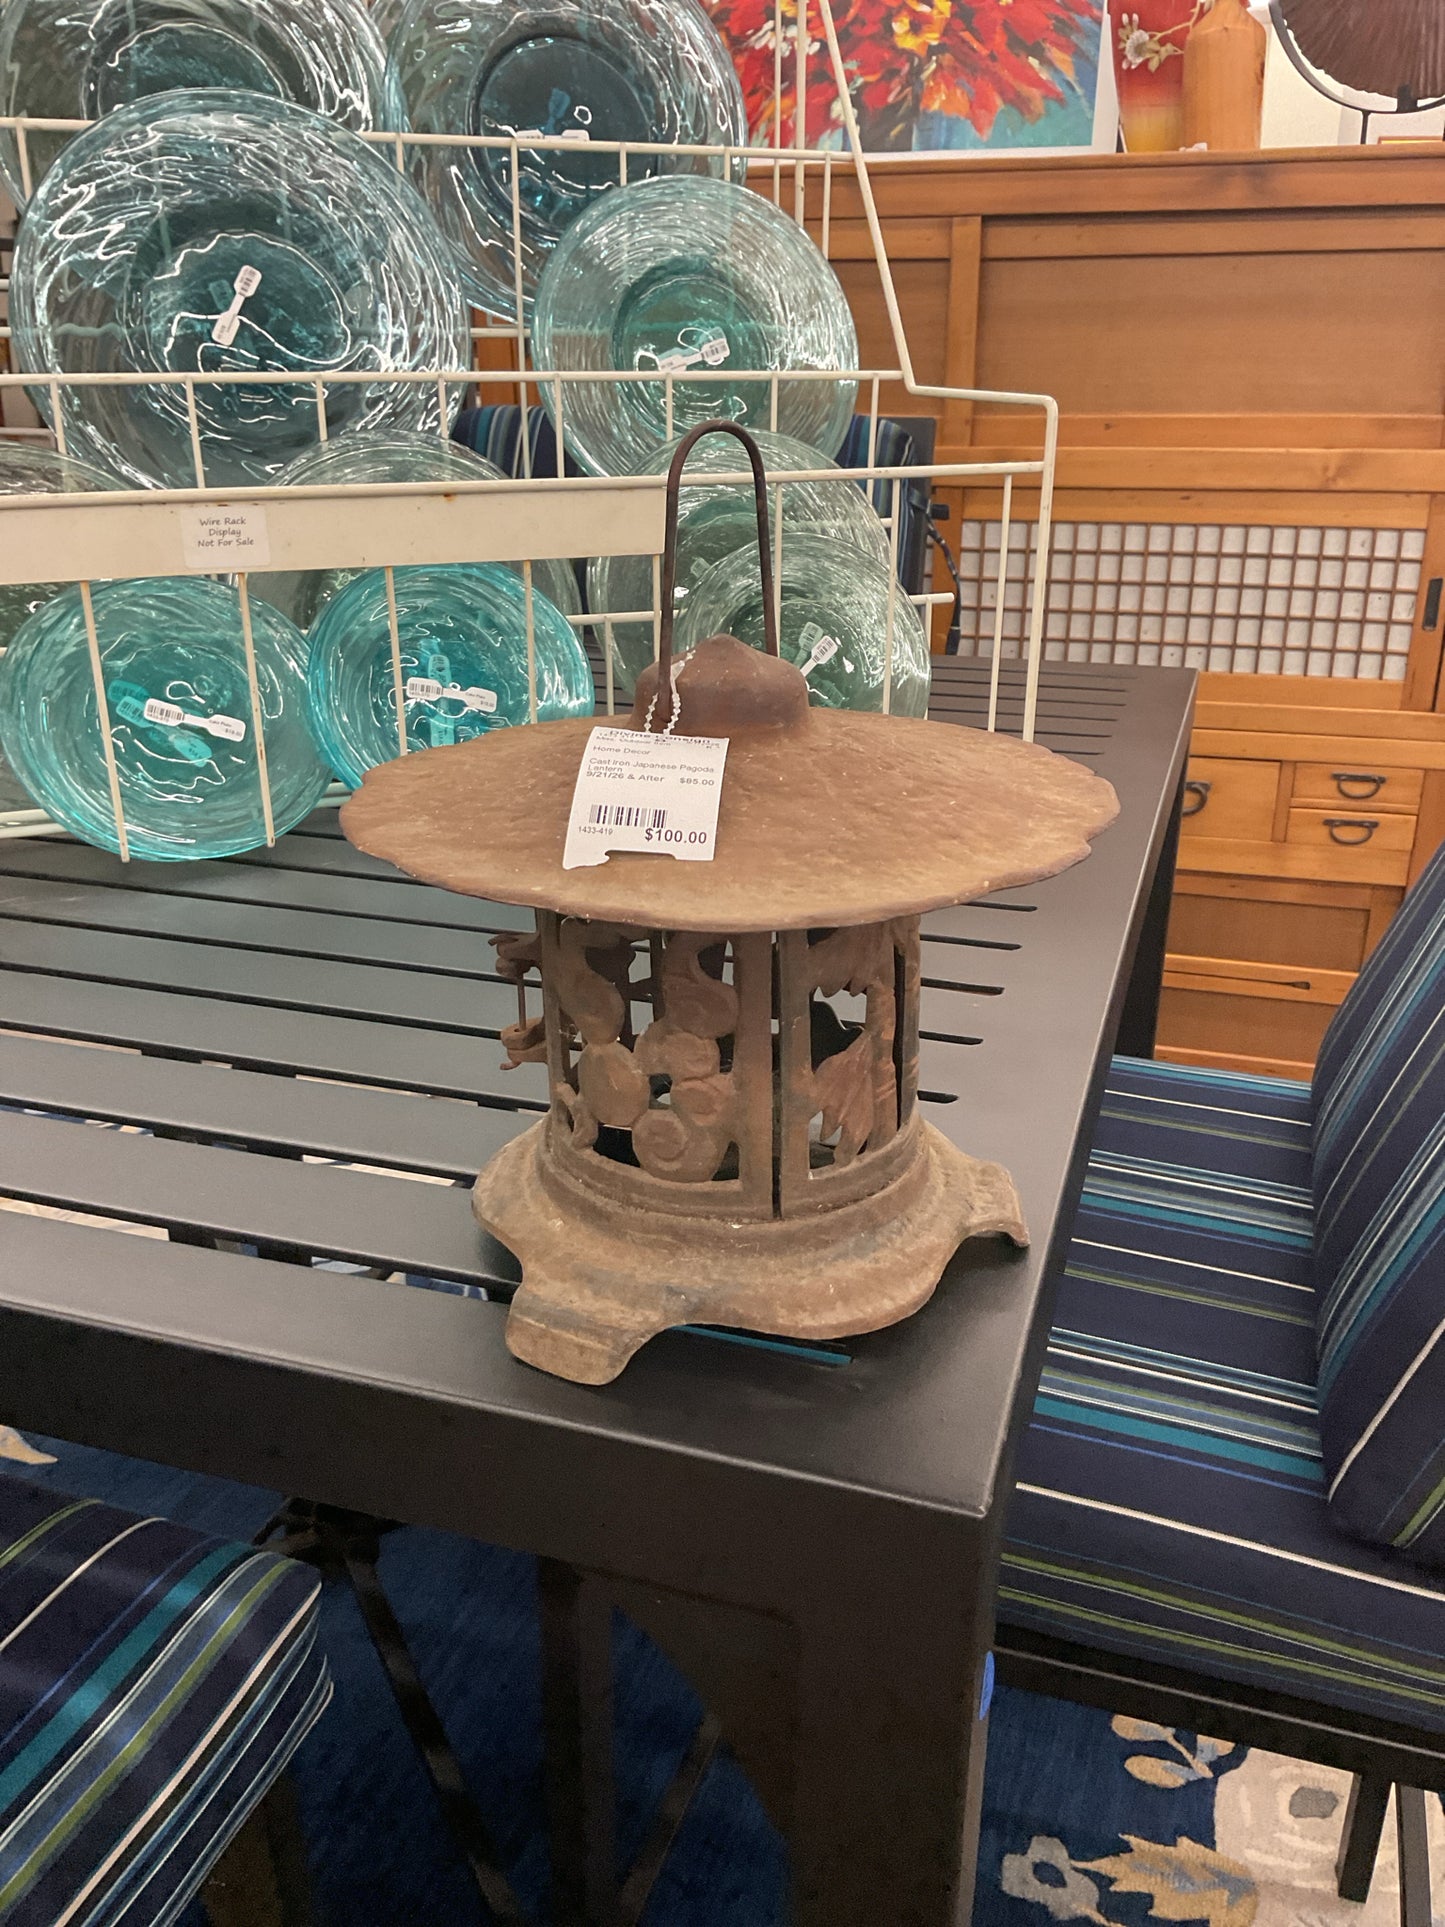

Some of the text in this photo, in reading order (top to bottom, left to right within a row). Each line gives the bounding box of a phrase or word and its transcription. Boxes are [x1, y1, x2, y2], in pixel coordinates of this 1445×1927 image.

[199, 516, 247, 526] Wire Rack
[208, 528, 242, 538] Display
[197, 537, 255, 548] Not For Sale
[593, 745, 652, 755] Home Decor
[587, 764, 623, 773] Lantern
[589, 757, 715, 773] Cast Iron Japanese Pagoda
[586, 771, 624, 780] 9/21/26
[638, 774, 665, 782] After
[578, 826, 614, 836] 1433-419
[644, 827, 708, 845] $100.00
